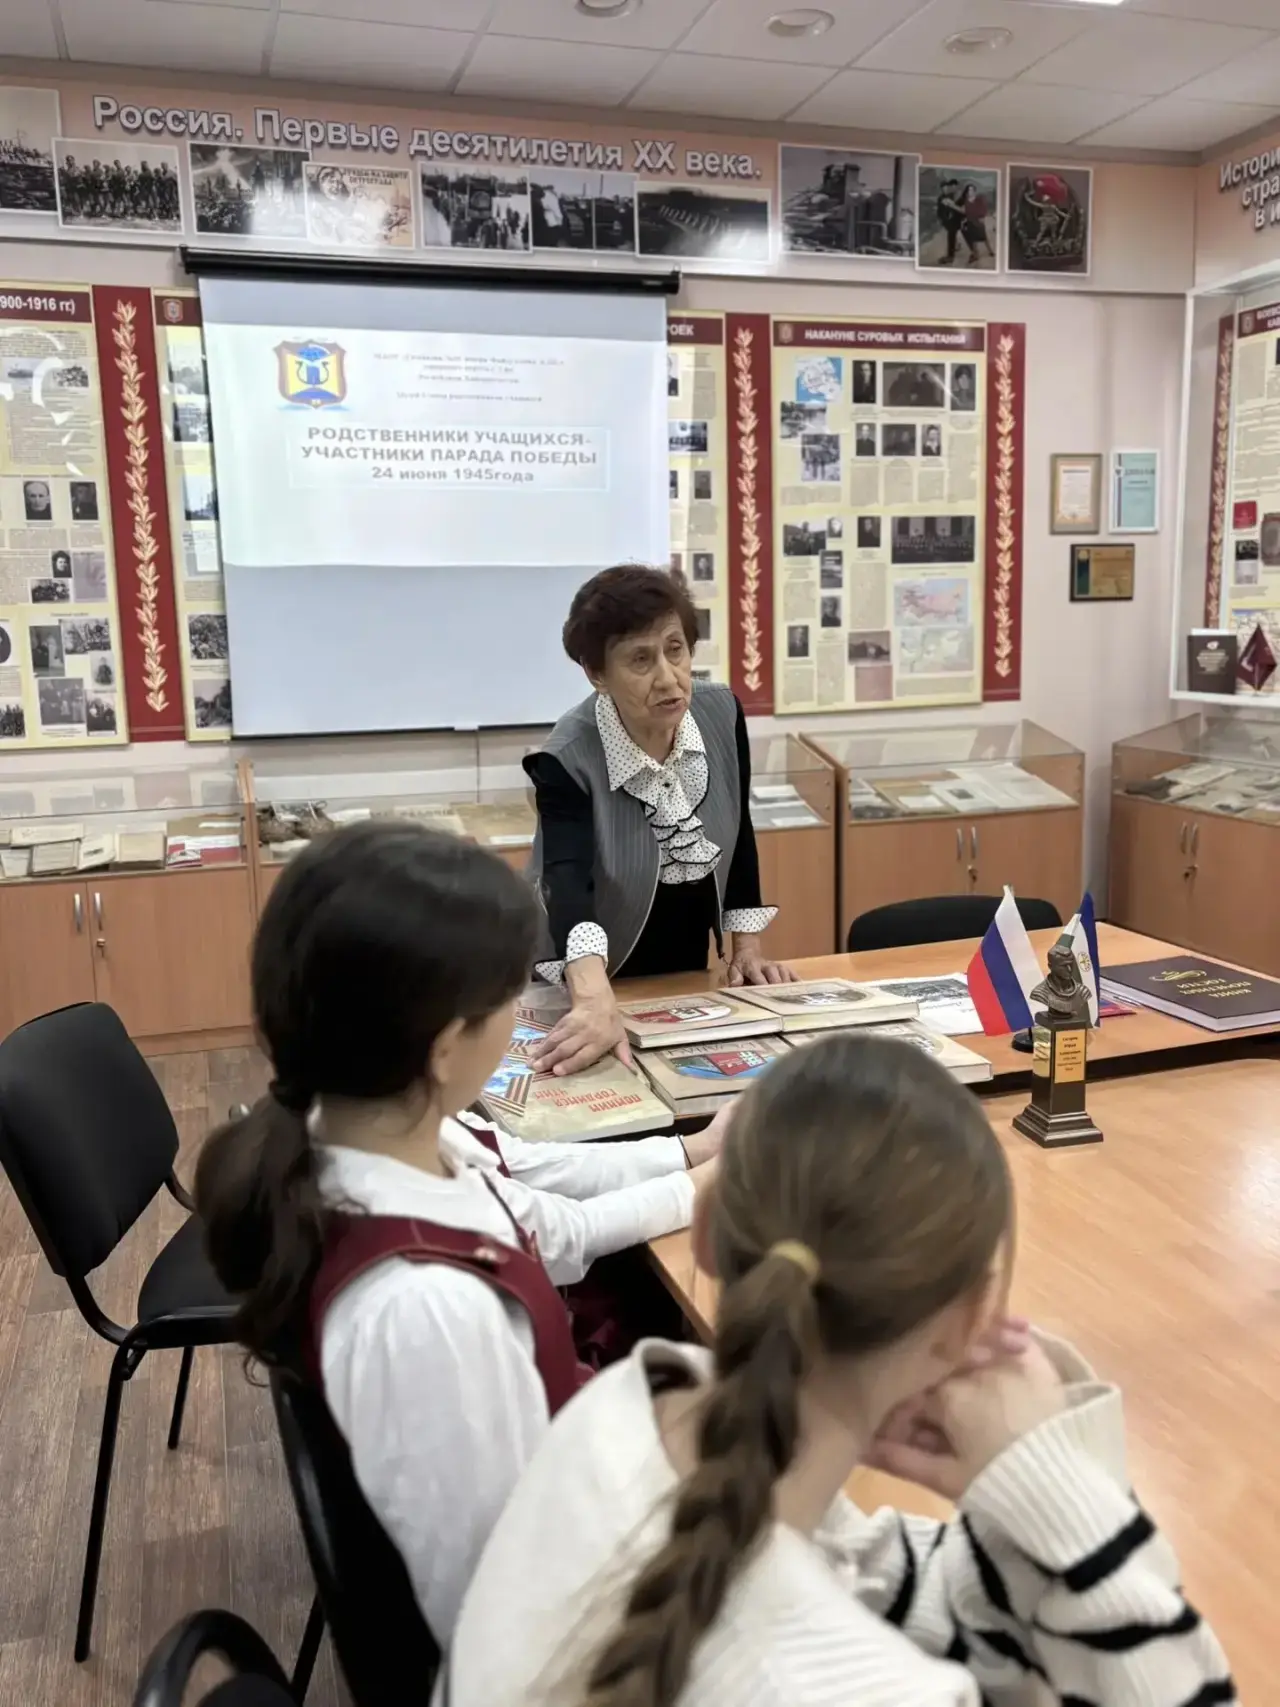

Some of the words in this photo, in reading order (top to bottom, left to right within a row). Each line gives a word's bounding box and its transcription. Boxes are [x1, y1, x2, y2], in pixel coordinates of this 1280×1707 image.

[92, 95, 243, 138] Россия.
[254, 107, 399, 150] Первые
[409, 128, 622, 168] десятилетия
[686, 149, 762, 178] века.
[1254, 208, 1265, 229] в
[804, 328, 856, 342] НАКАНУНЕ
[857, 330, 904, 343] СУРОВЫХ
[307, 427, 469, 443] РОДСТВЕННИКИ
[301, 446, 425, 462] УЧАСТНИКИ
[431, 448, 505, 464] ПАРАДА
[510, 450, 597, 466] ПОБЕДЫ
[371, 466, 394, 479] 24
[399, 469, 447, 480] июня
[453, 468, 534, 483] 1945года
[534, 1086, 569, 1101] ЧТИМ
[553, 1087, 618, 1108] ГОРДИМСЯ
[588, 1094, 643, 1113] ПОМНИМ
